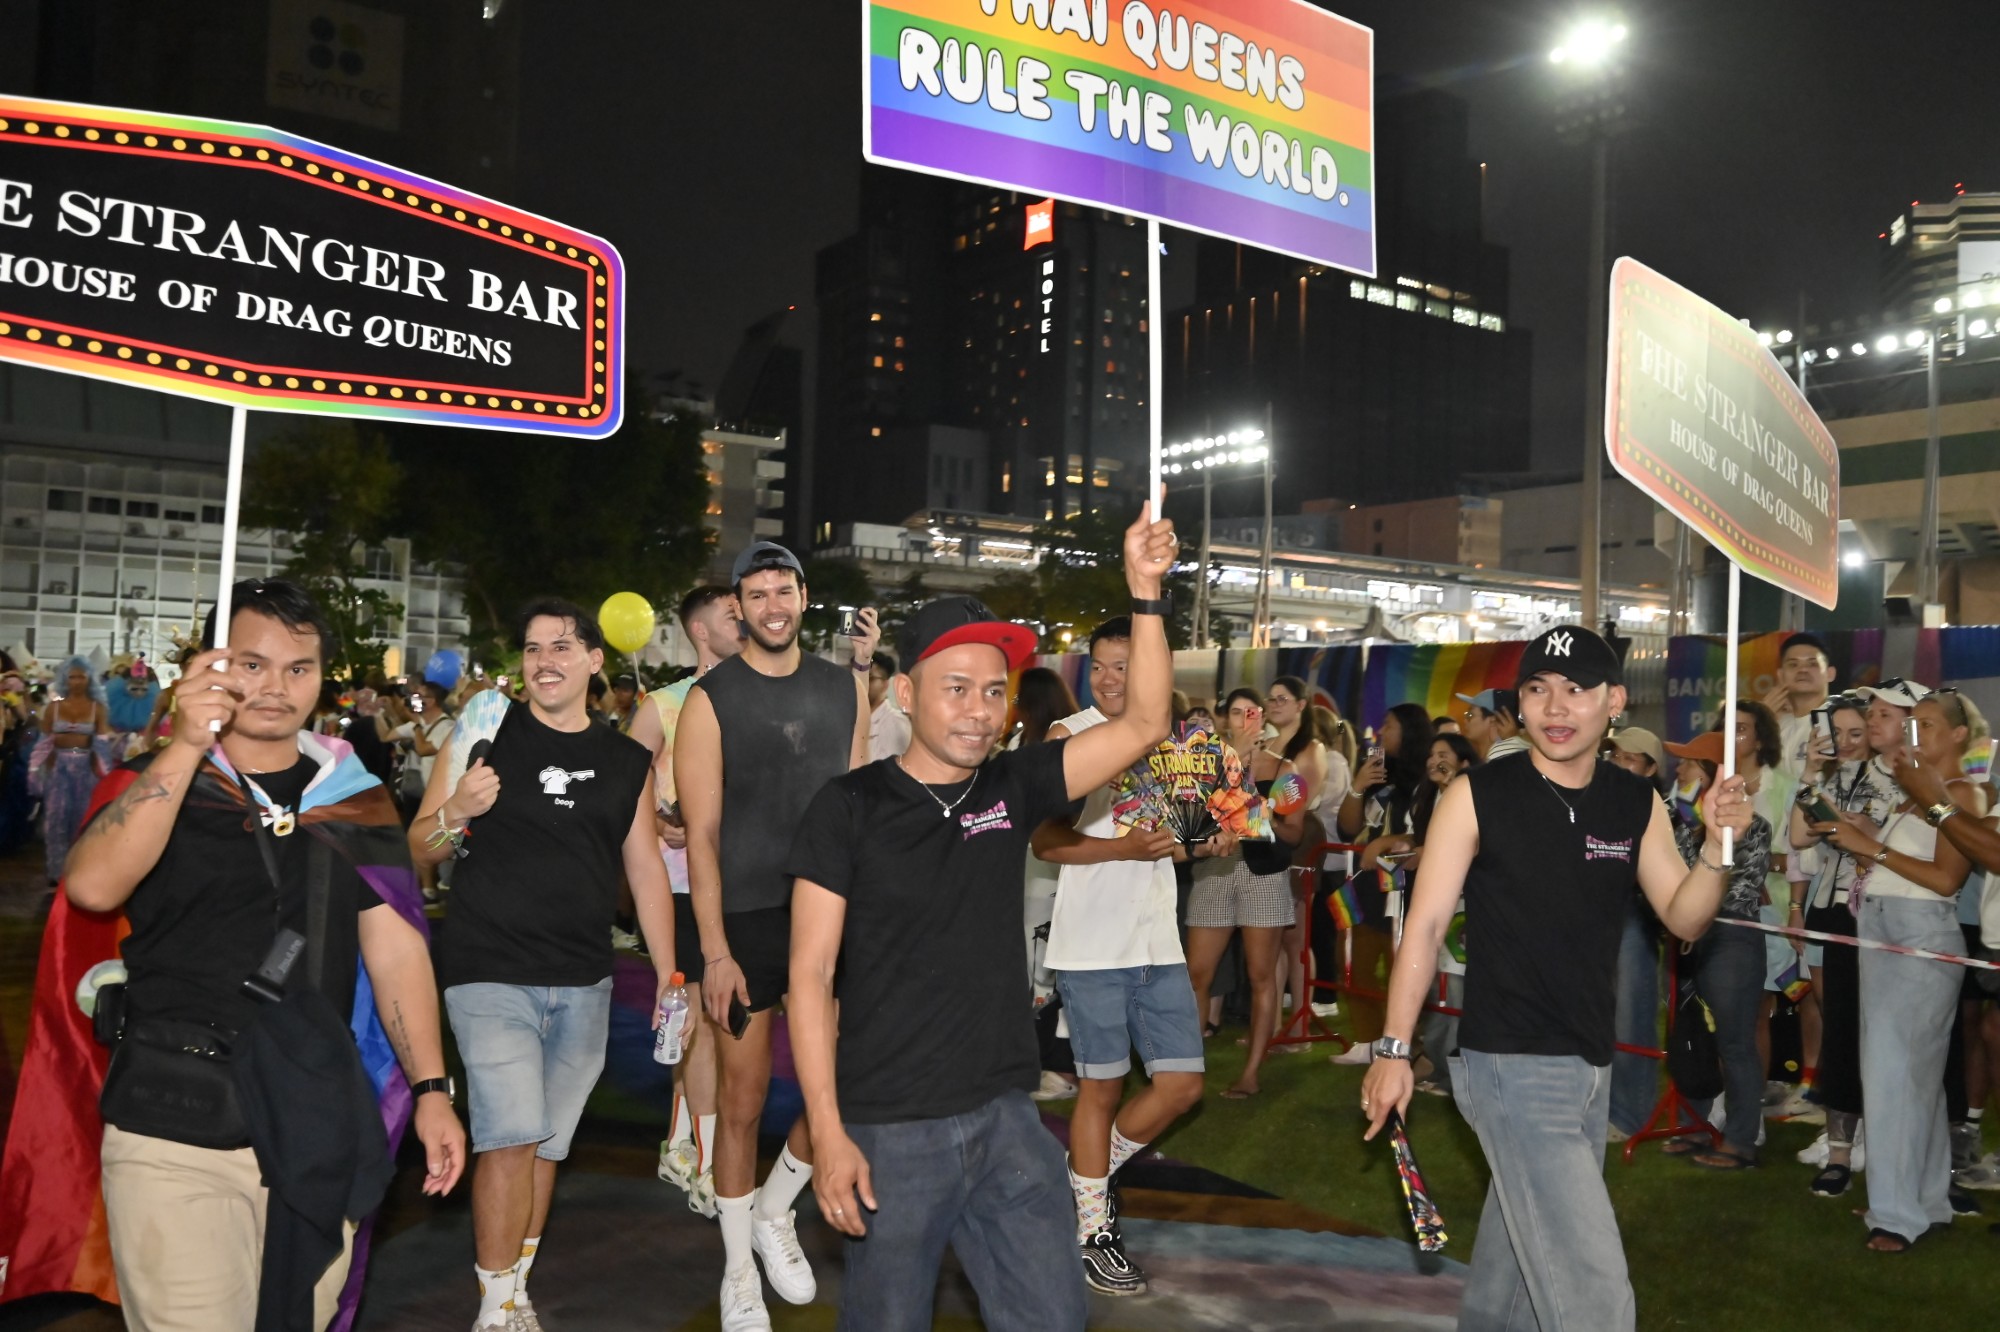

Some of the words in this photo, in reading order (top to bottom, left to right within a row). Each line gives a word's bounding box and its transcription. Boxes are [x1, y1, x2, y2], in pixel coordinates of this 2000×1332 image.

[979, 0, 1108, 46] AI
[1122, 0, 1306, 110] QUEENS
[898, 26, 1053, 121] RULE
[1064, 69, 1173, 153] THE
[1184, 103, 1350, 208] WORLD.
[56, 190, 449, 302] STRANGER
[466, 268, 581, 330] BAR
[158, 279, 218, 313] OF
[236, 291, 353, 338] DRAG
[363, 316, 513, 367] QUEENS
[1669, 418, 1717, 472] HOUSE
[1722, 456, 1739, 486] OF
[1743, 472, 1774, 514] DRAG
[1775, 496, 1814, 546] QUEENS
[1694, 373, 1799, 489] STRANGER
[1802, 463, 1830, 518] BAR
[1544, 630, 1575, 657] NY
[554, 797, 575, 808] boop
[1150, 753, 1217, 778] STRANGER
[1177, 775, 1194, 788] BAR
[1286, 778, 1302, 803] MBK
